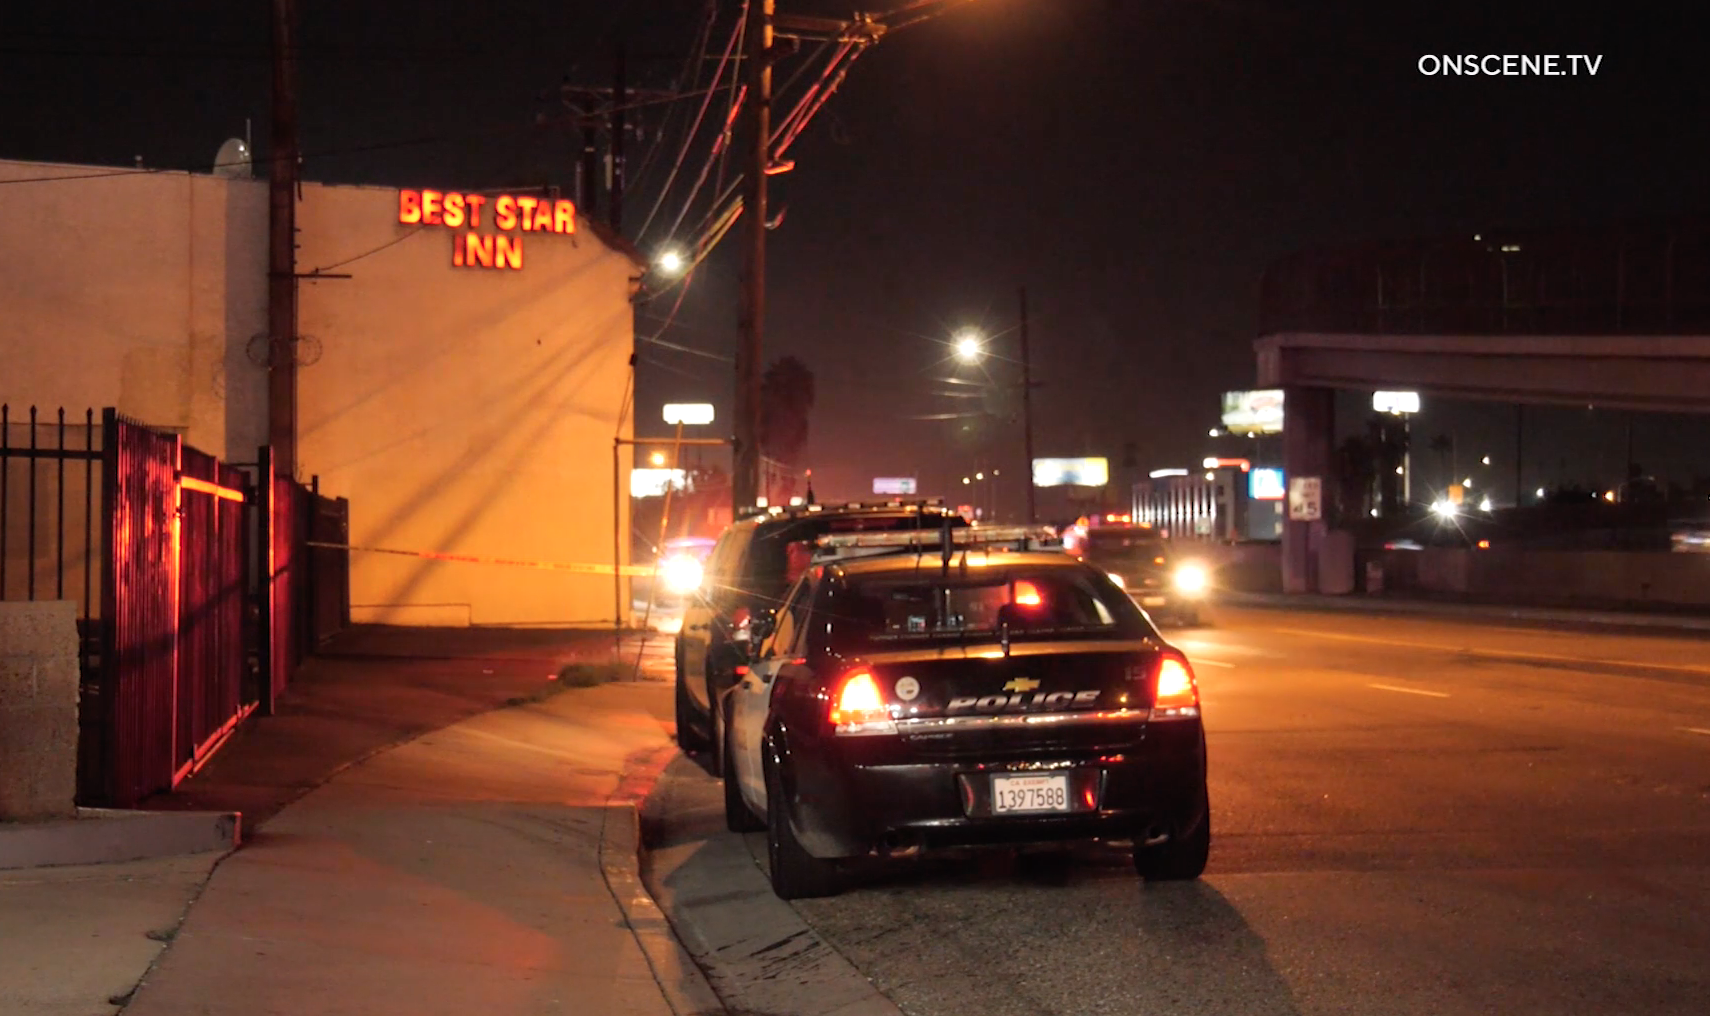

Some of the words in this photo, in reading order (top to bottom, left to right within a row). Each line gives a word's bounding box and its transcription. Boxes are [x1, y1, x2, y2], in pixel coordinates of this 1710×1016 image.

[399, 189, 485, 228] BEST
[495, 195, 576, 234] STAR
[453, 232, 523, 270] INN
[946, 690, 1102, 711] POLICE
[998, 787, 1065, 808] 1397588
